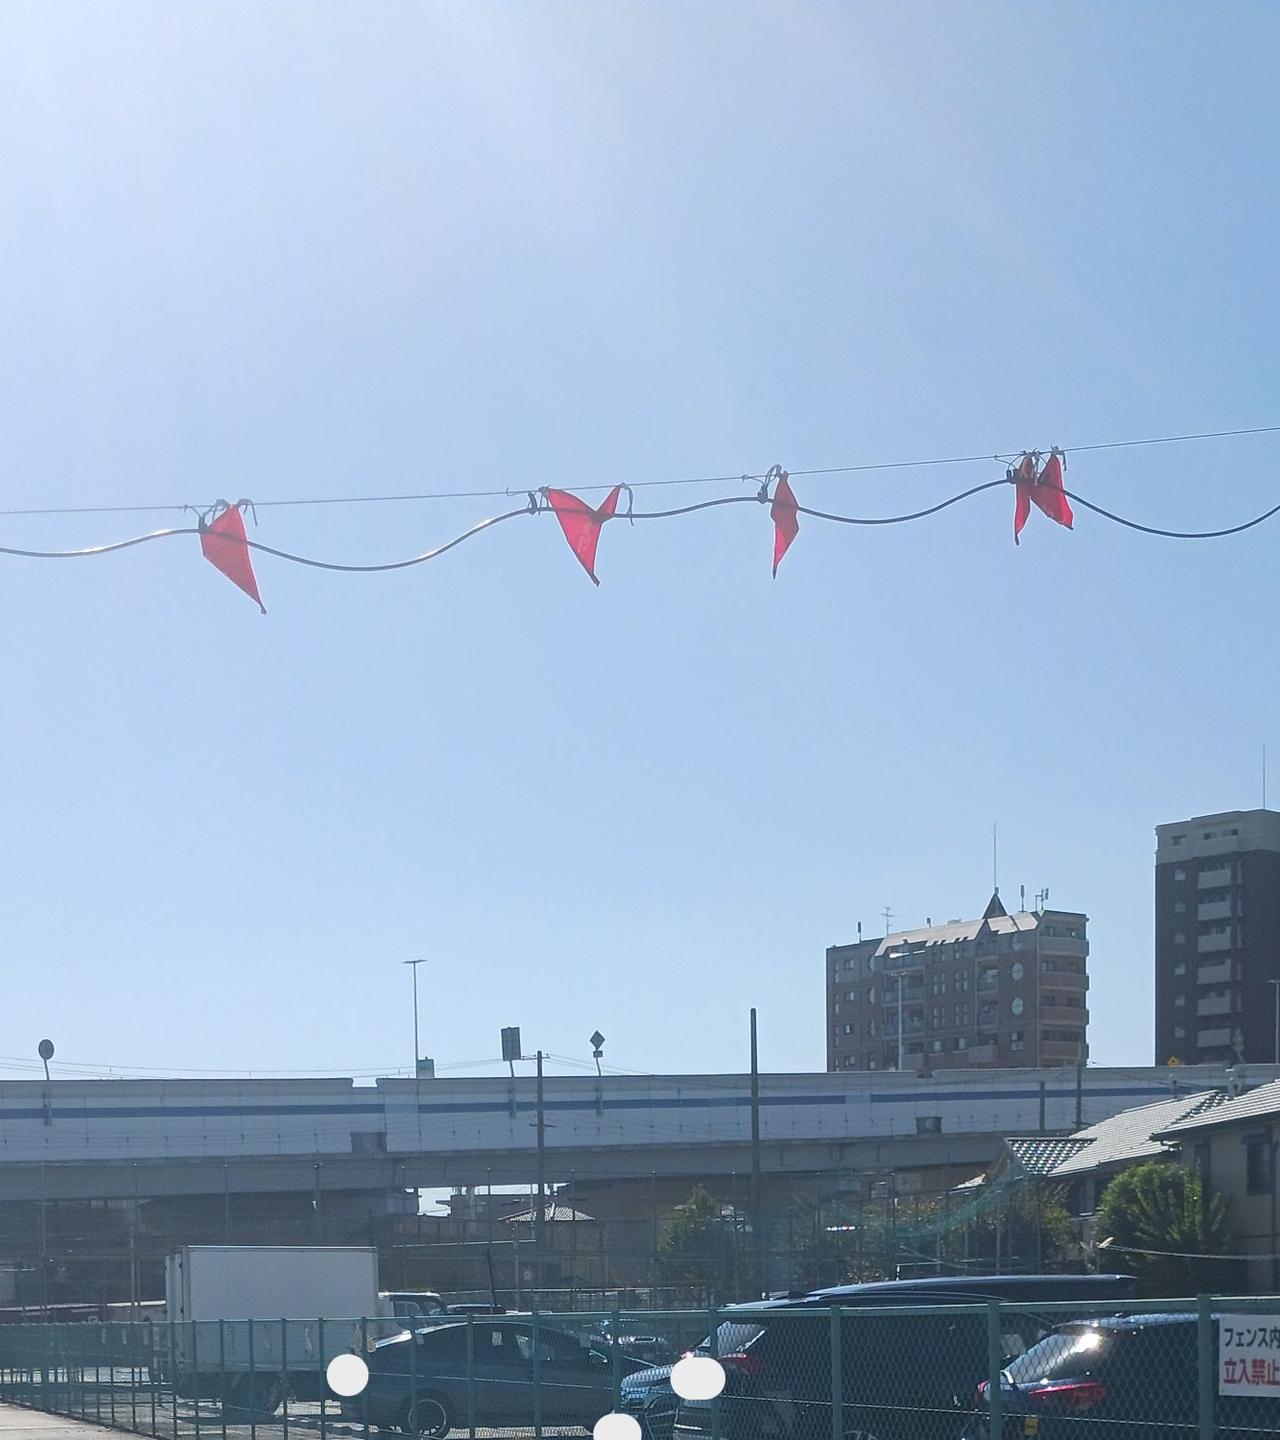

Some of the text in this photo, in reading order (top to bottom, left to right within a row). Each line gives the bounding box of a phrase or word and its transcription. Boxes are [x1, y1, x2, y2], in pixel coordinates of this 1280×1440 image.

[1223, 1325, 1280, 1350] フェンス内
[1223, 1357, 1280, 1386] 立入禁止
